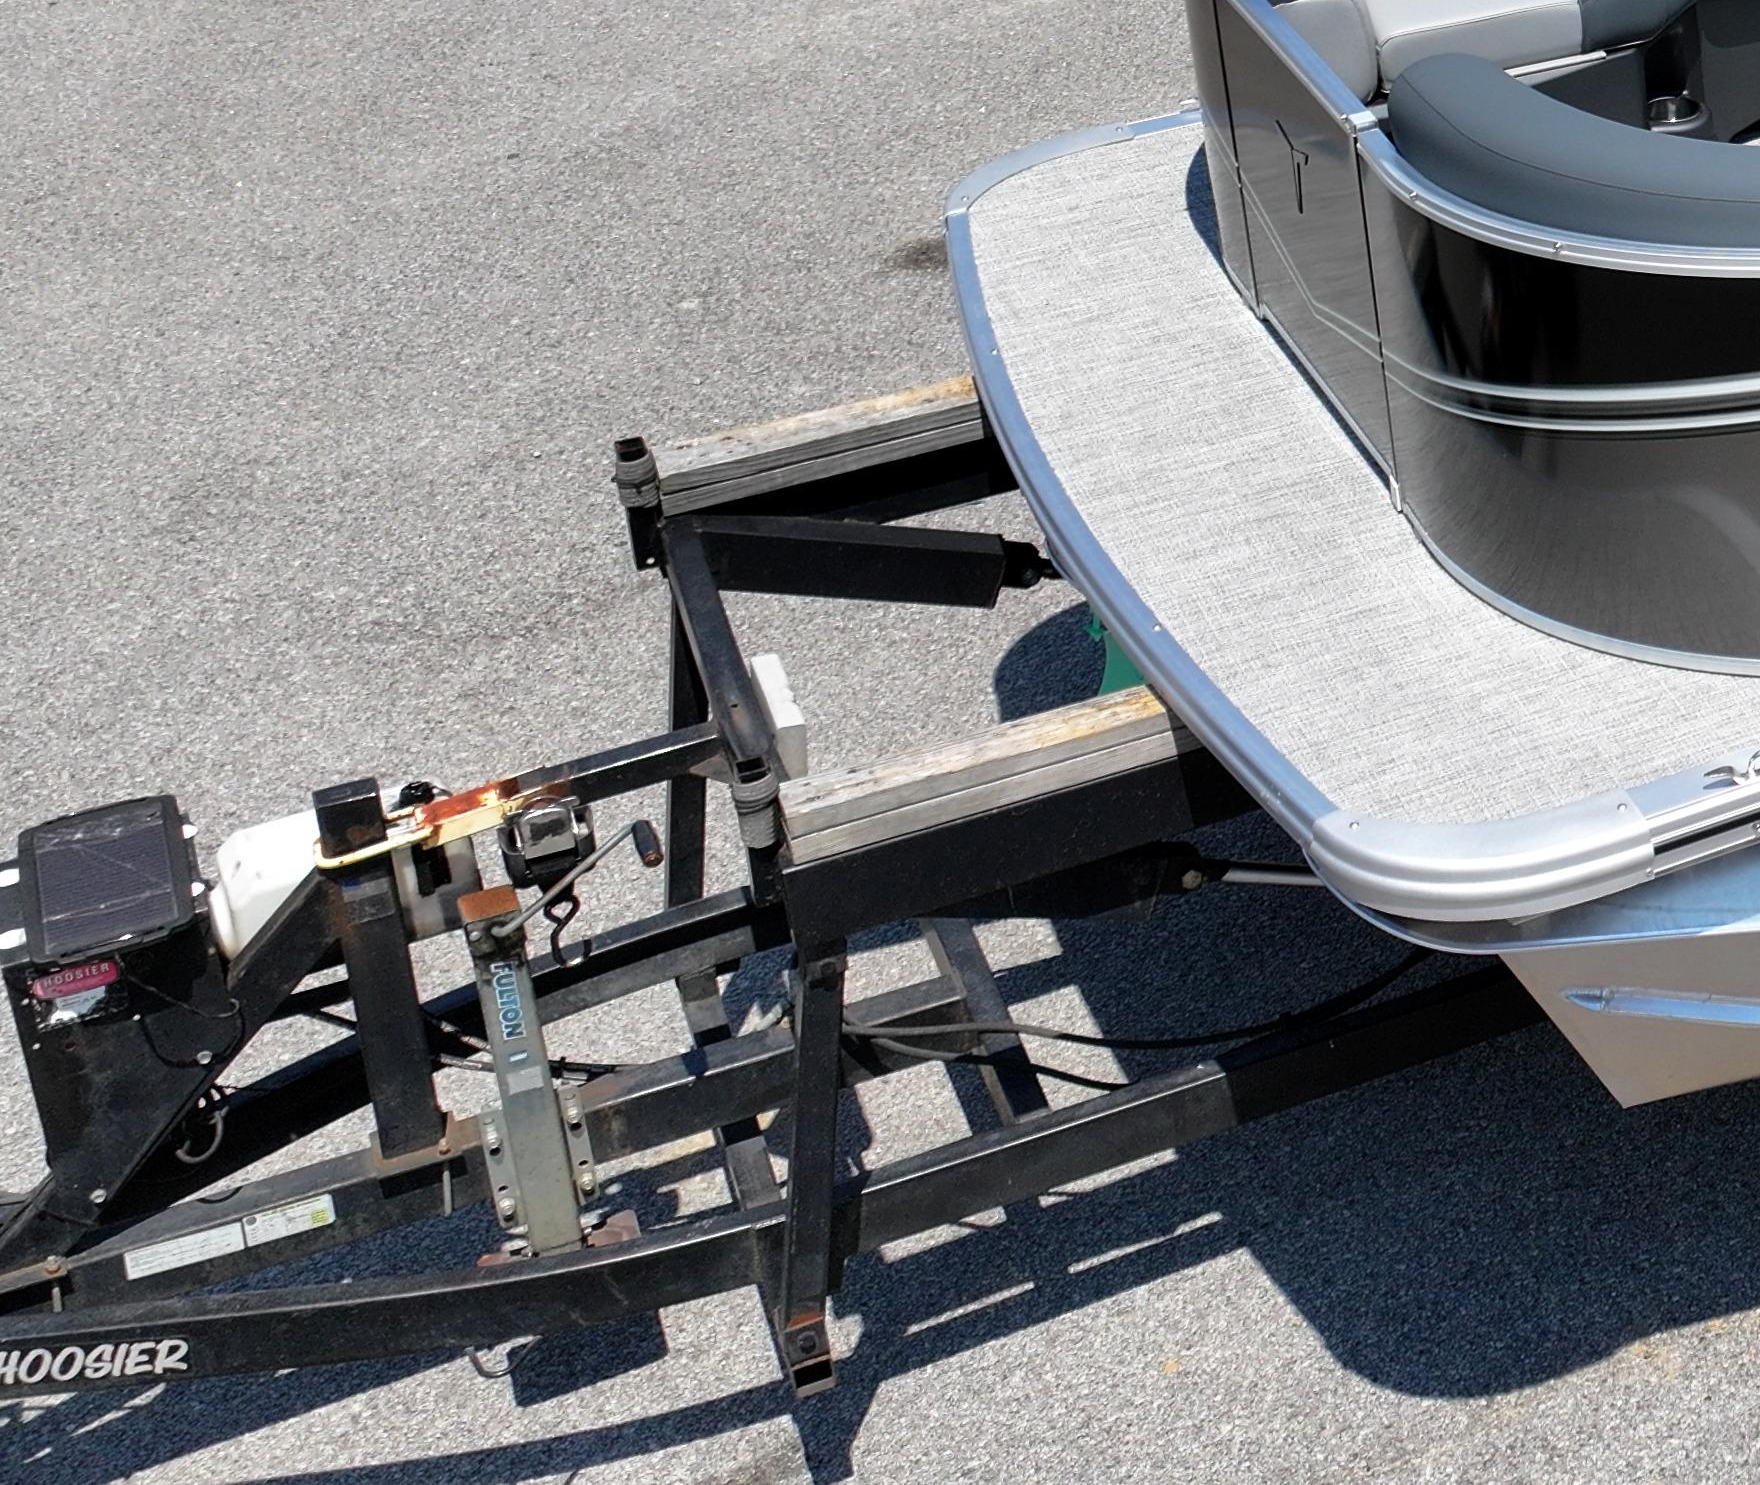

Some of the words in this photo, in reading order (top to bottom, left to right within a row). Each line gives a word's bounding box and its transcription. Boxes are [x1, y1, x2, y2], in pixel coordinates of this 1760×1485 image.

[43, 961, 110, 988] HOOSIER
[489, 961, 527, 1040] FULTON
[0, 1339, 189, 1385] HOOSIER
